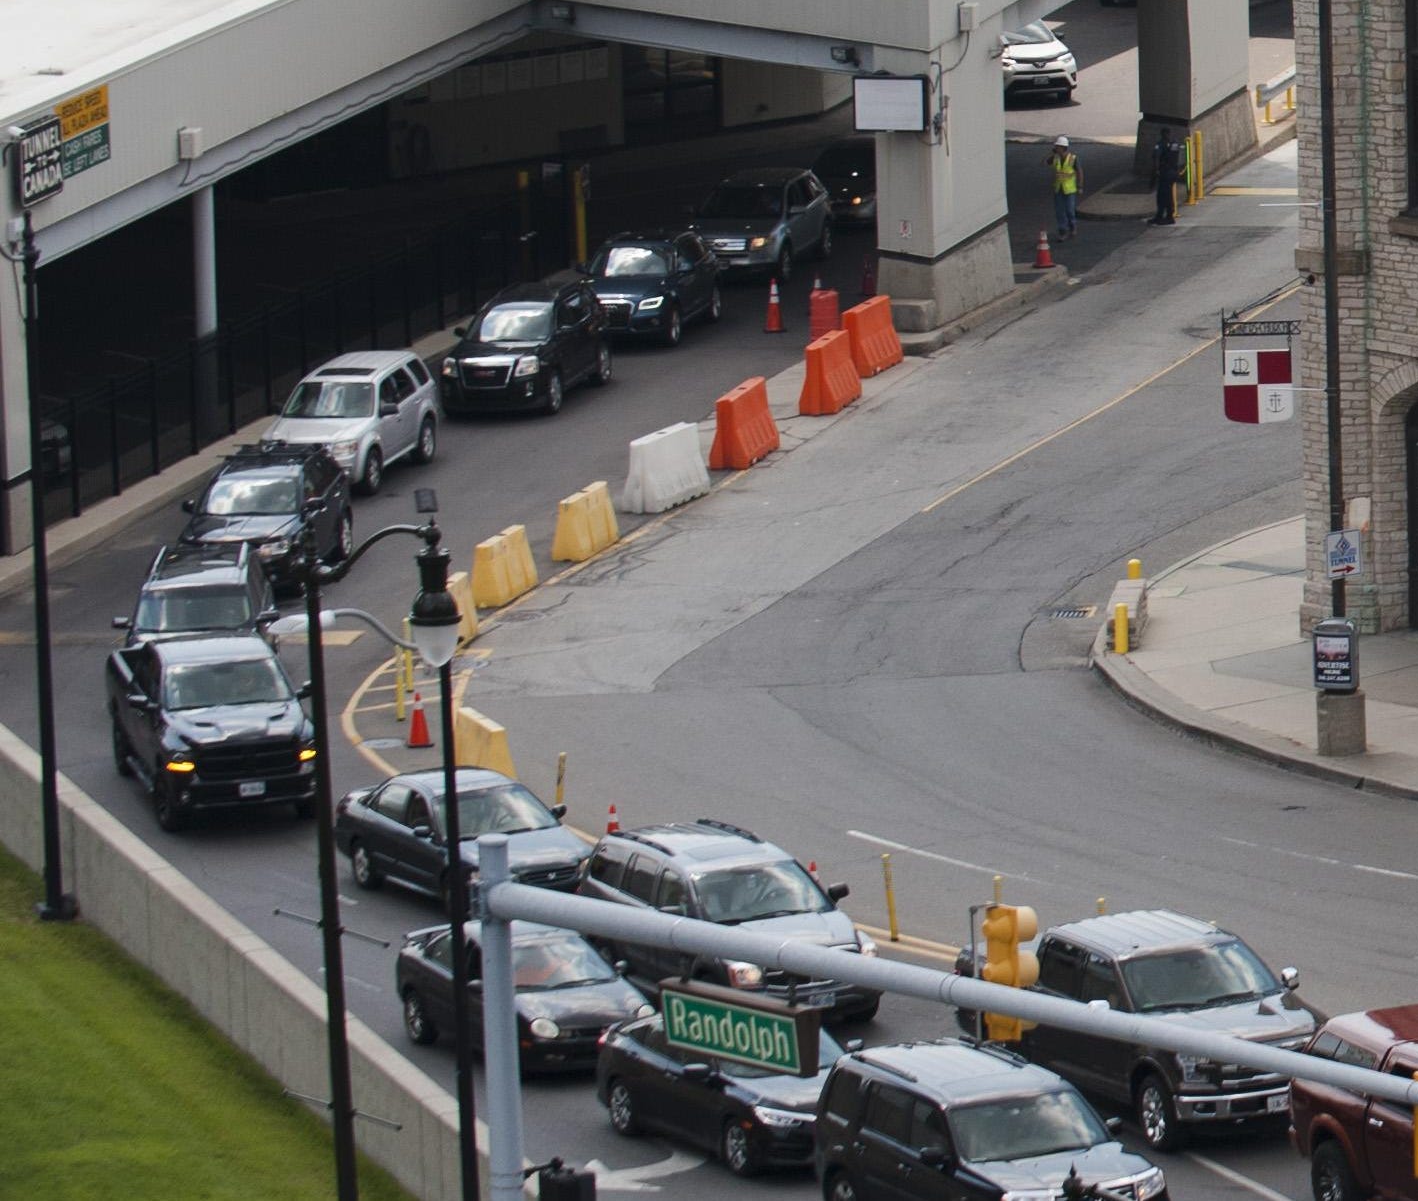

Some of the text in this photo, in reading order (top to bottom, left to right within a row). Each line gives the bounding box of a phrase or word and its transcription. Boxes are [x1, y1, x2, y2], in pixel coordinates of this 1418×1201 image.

[23, 126, 60, 159] TUNNEL
[25, 163, 62, 197] CANADA
[671, 998, 790, 1062] Randolph
